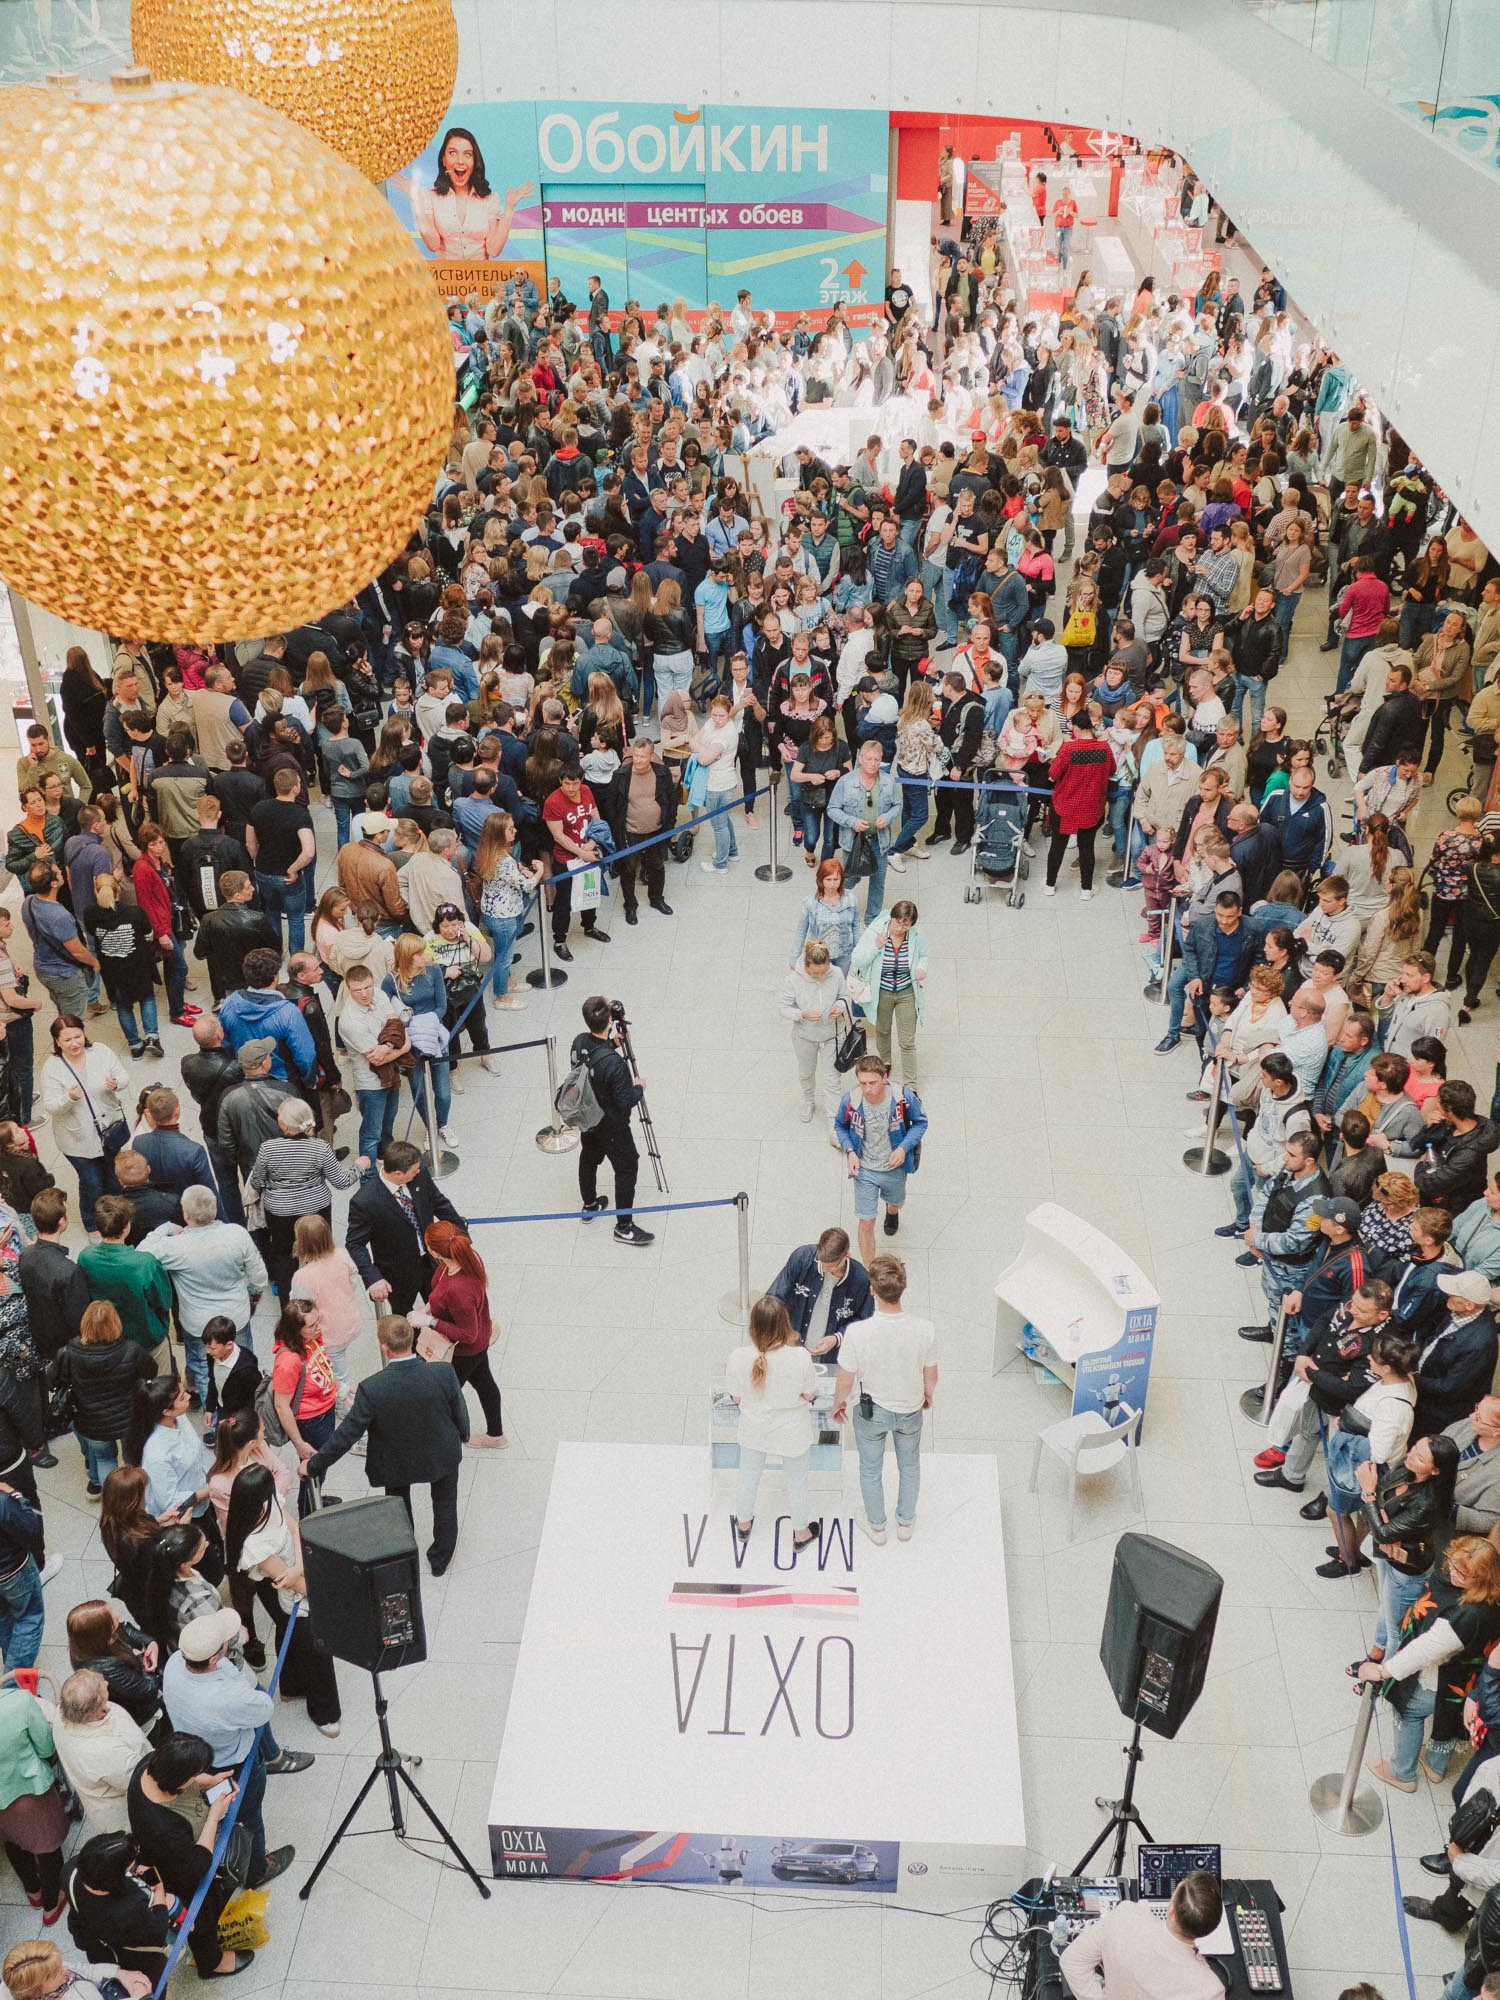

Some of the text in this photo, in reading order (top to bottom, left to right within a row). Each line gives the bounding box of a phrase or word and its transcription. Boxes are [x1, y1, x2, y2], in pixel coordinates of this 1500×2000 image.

[539, 110, 828, 173] Обойкин
[738, 203, 804, 225] обоев
[429, 266, 529, 282] ЙСТВИТЕЛЬ
[819, 257, 840, 289] 2
[818, 289, 868, 304] этаж
[670, 1632, 855, 1740] ОХТА
[501, 1830, 547, 1853] ОХТА
[505, 1861, 549, 1875] МОЛЛ
